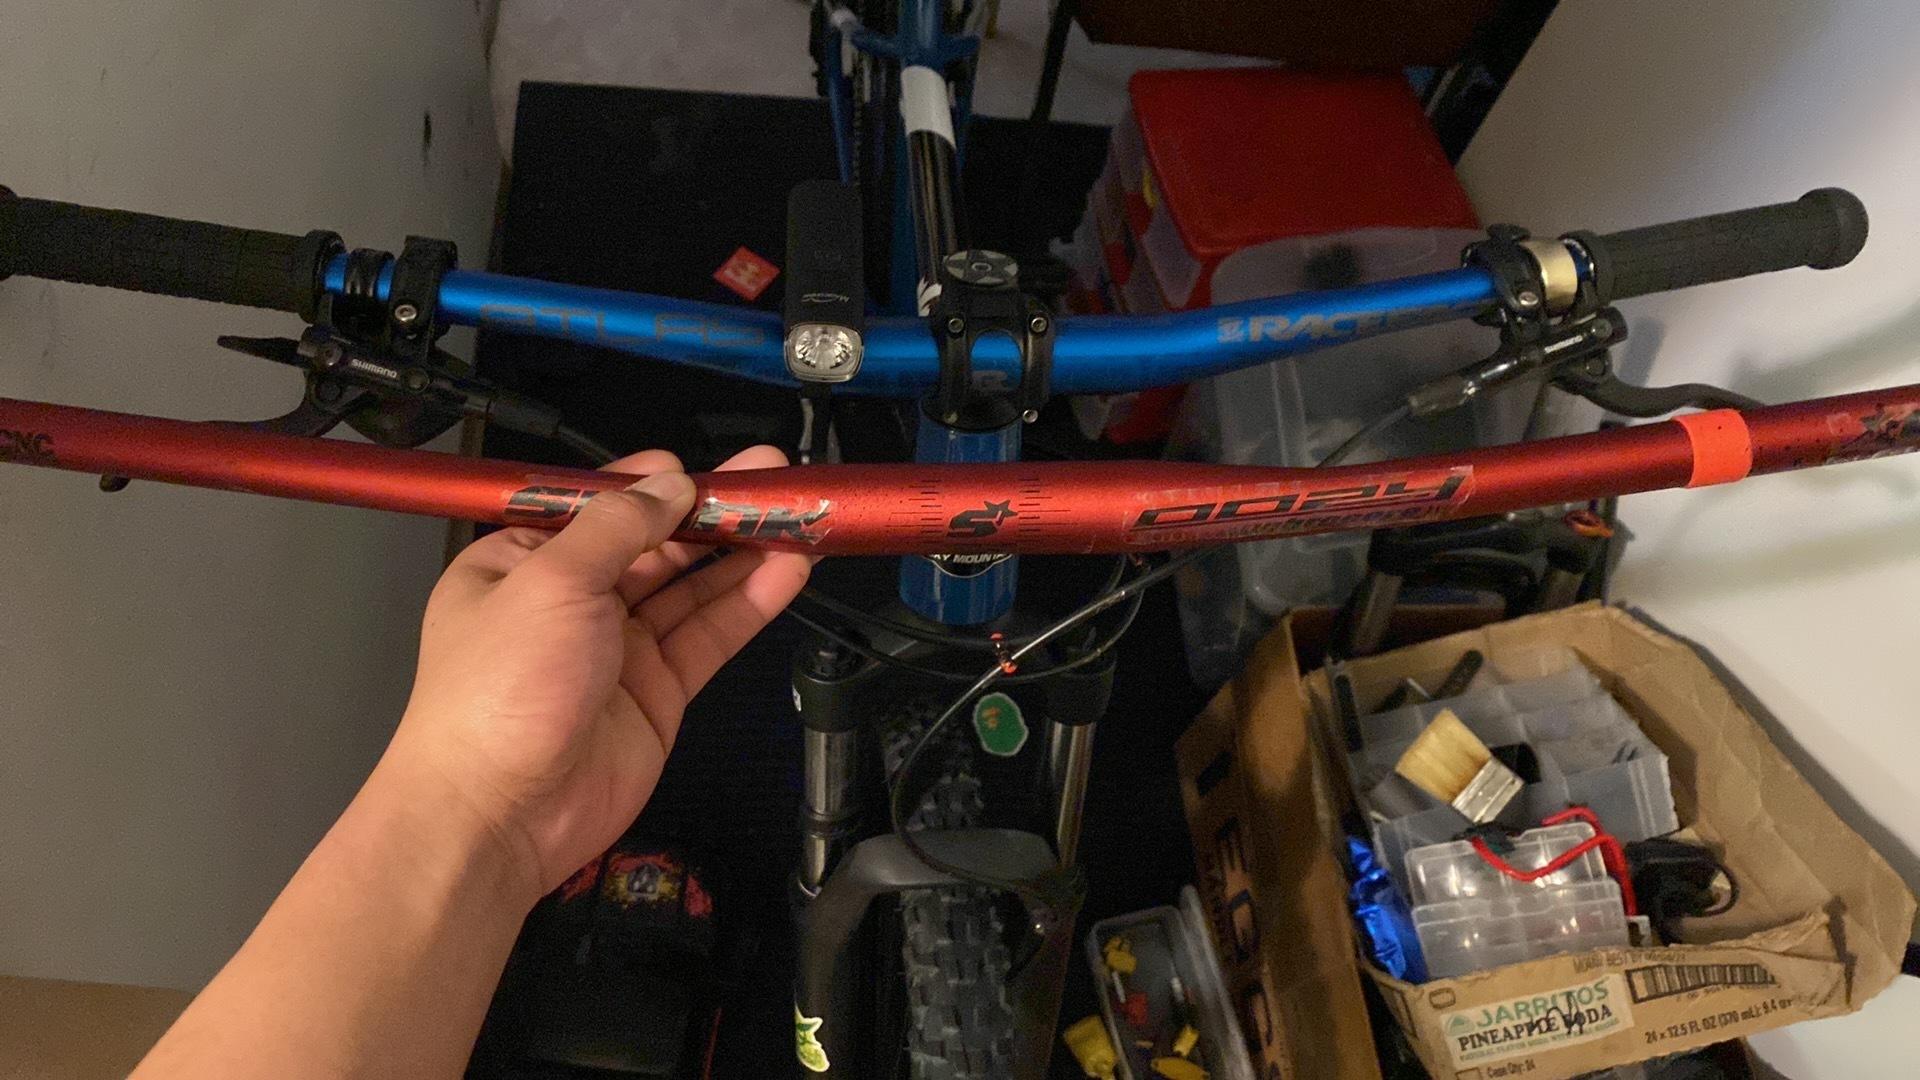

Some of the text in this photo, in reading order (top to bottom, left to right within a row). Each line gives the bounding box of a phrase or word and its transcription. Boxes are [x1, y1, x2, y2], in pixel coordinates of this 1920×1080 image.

[351, 358, 398, 378] SHIMANO
[501, 486, 833, 545] SNK
[1477, 976, 1610, 1028] JARRITOS
[1458, 1016, 1561, 1052] PINEAPPLE
[1644, 1031, 1658, 1044] 24
